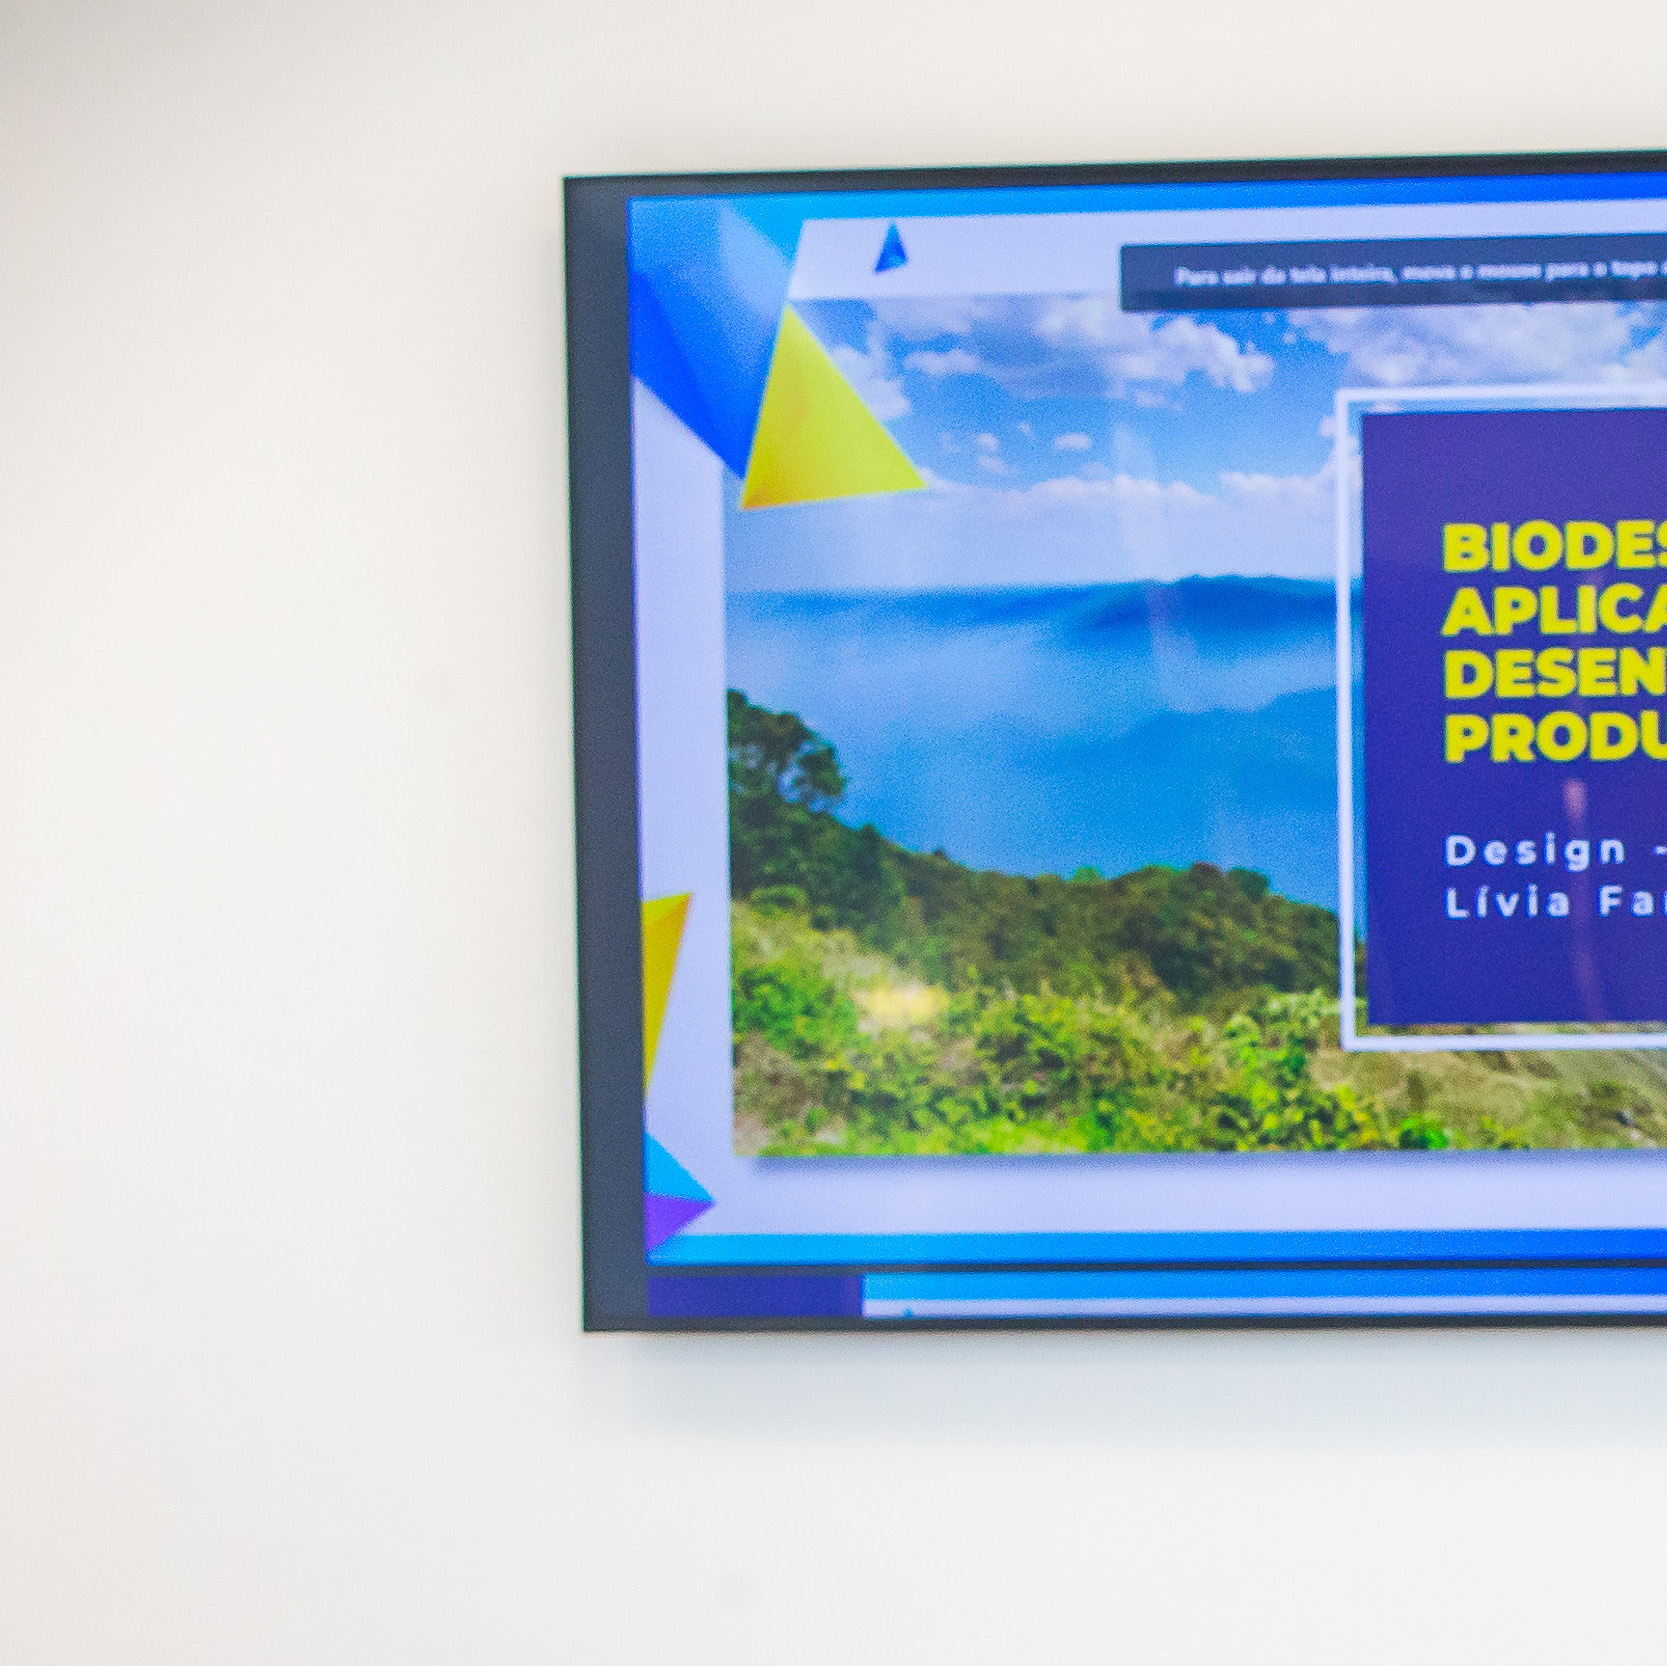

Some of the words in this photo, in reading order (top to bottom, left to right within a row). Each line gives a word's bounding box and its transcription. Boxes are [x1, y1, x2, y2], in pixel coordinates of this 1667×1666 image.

[1174, 267, 1219, 286] Para
[1259, 267, 1287, 284] da
[1288, 266, 1327, 283] tela
[1459, 265, 1475, 280] o
[1545, 262, 1590, 281] para
[1592, 262, 1608, 277] o
[1446, 832, 1624, 872] Design
[1446, 885, 1569, 918] Lívia
